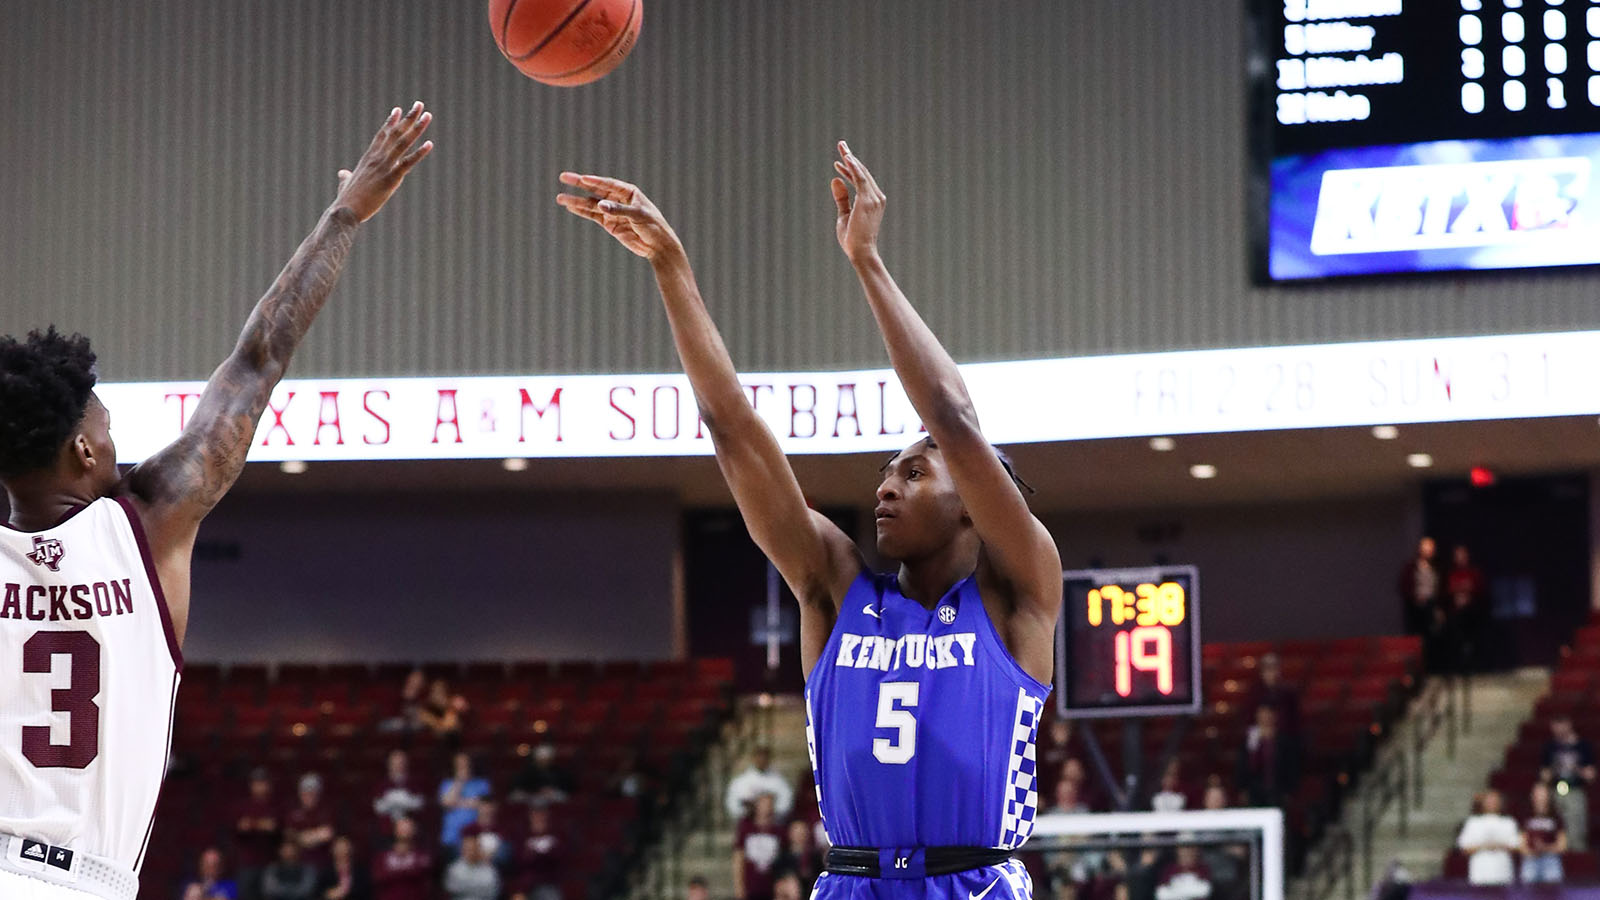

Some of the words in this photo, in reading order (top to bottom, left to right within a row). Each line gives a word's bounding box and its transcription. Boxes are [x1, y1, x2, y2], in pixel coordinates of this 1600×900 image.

[165, 389, 391, 446] TXAS
[609, 382, 928, 441] SOTBAL
[939, 606, 957, 623] SEC
[1087, 581, 1185, 627] 17:38
[835, 632, 977, 671] KENTUCKY
[1115, 625, 1173, 697] 19
[22, 630, 100, 769] 3
[872, 681, 920, 765] 5
